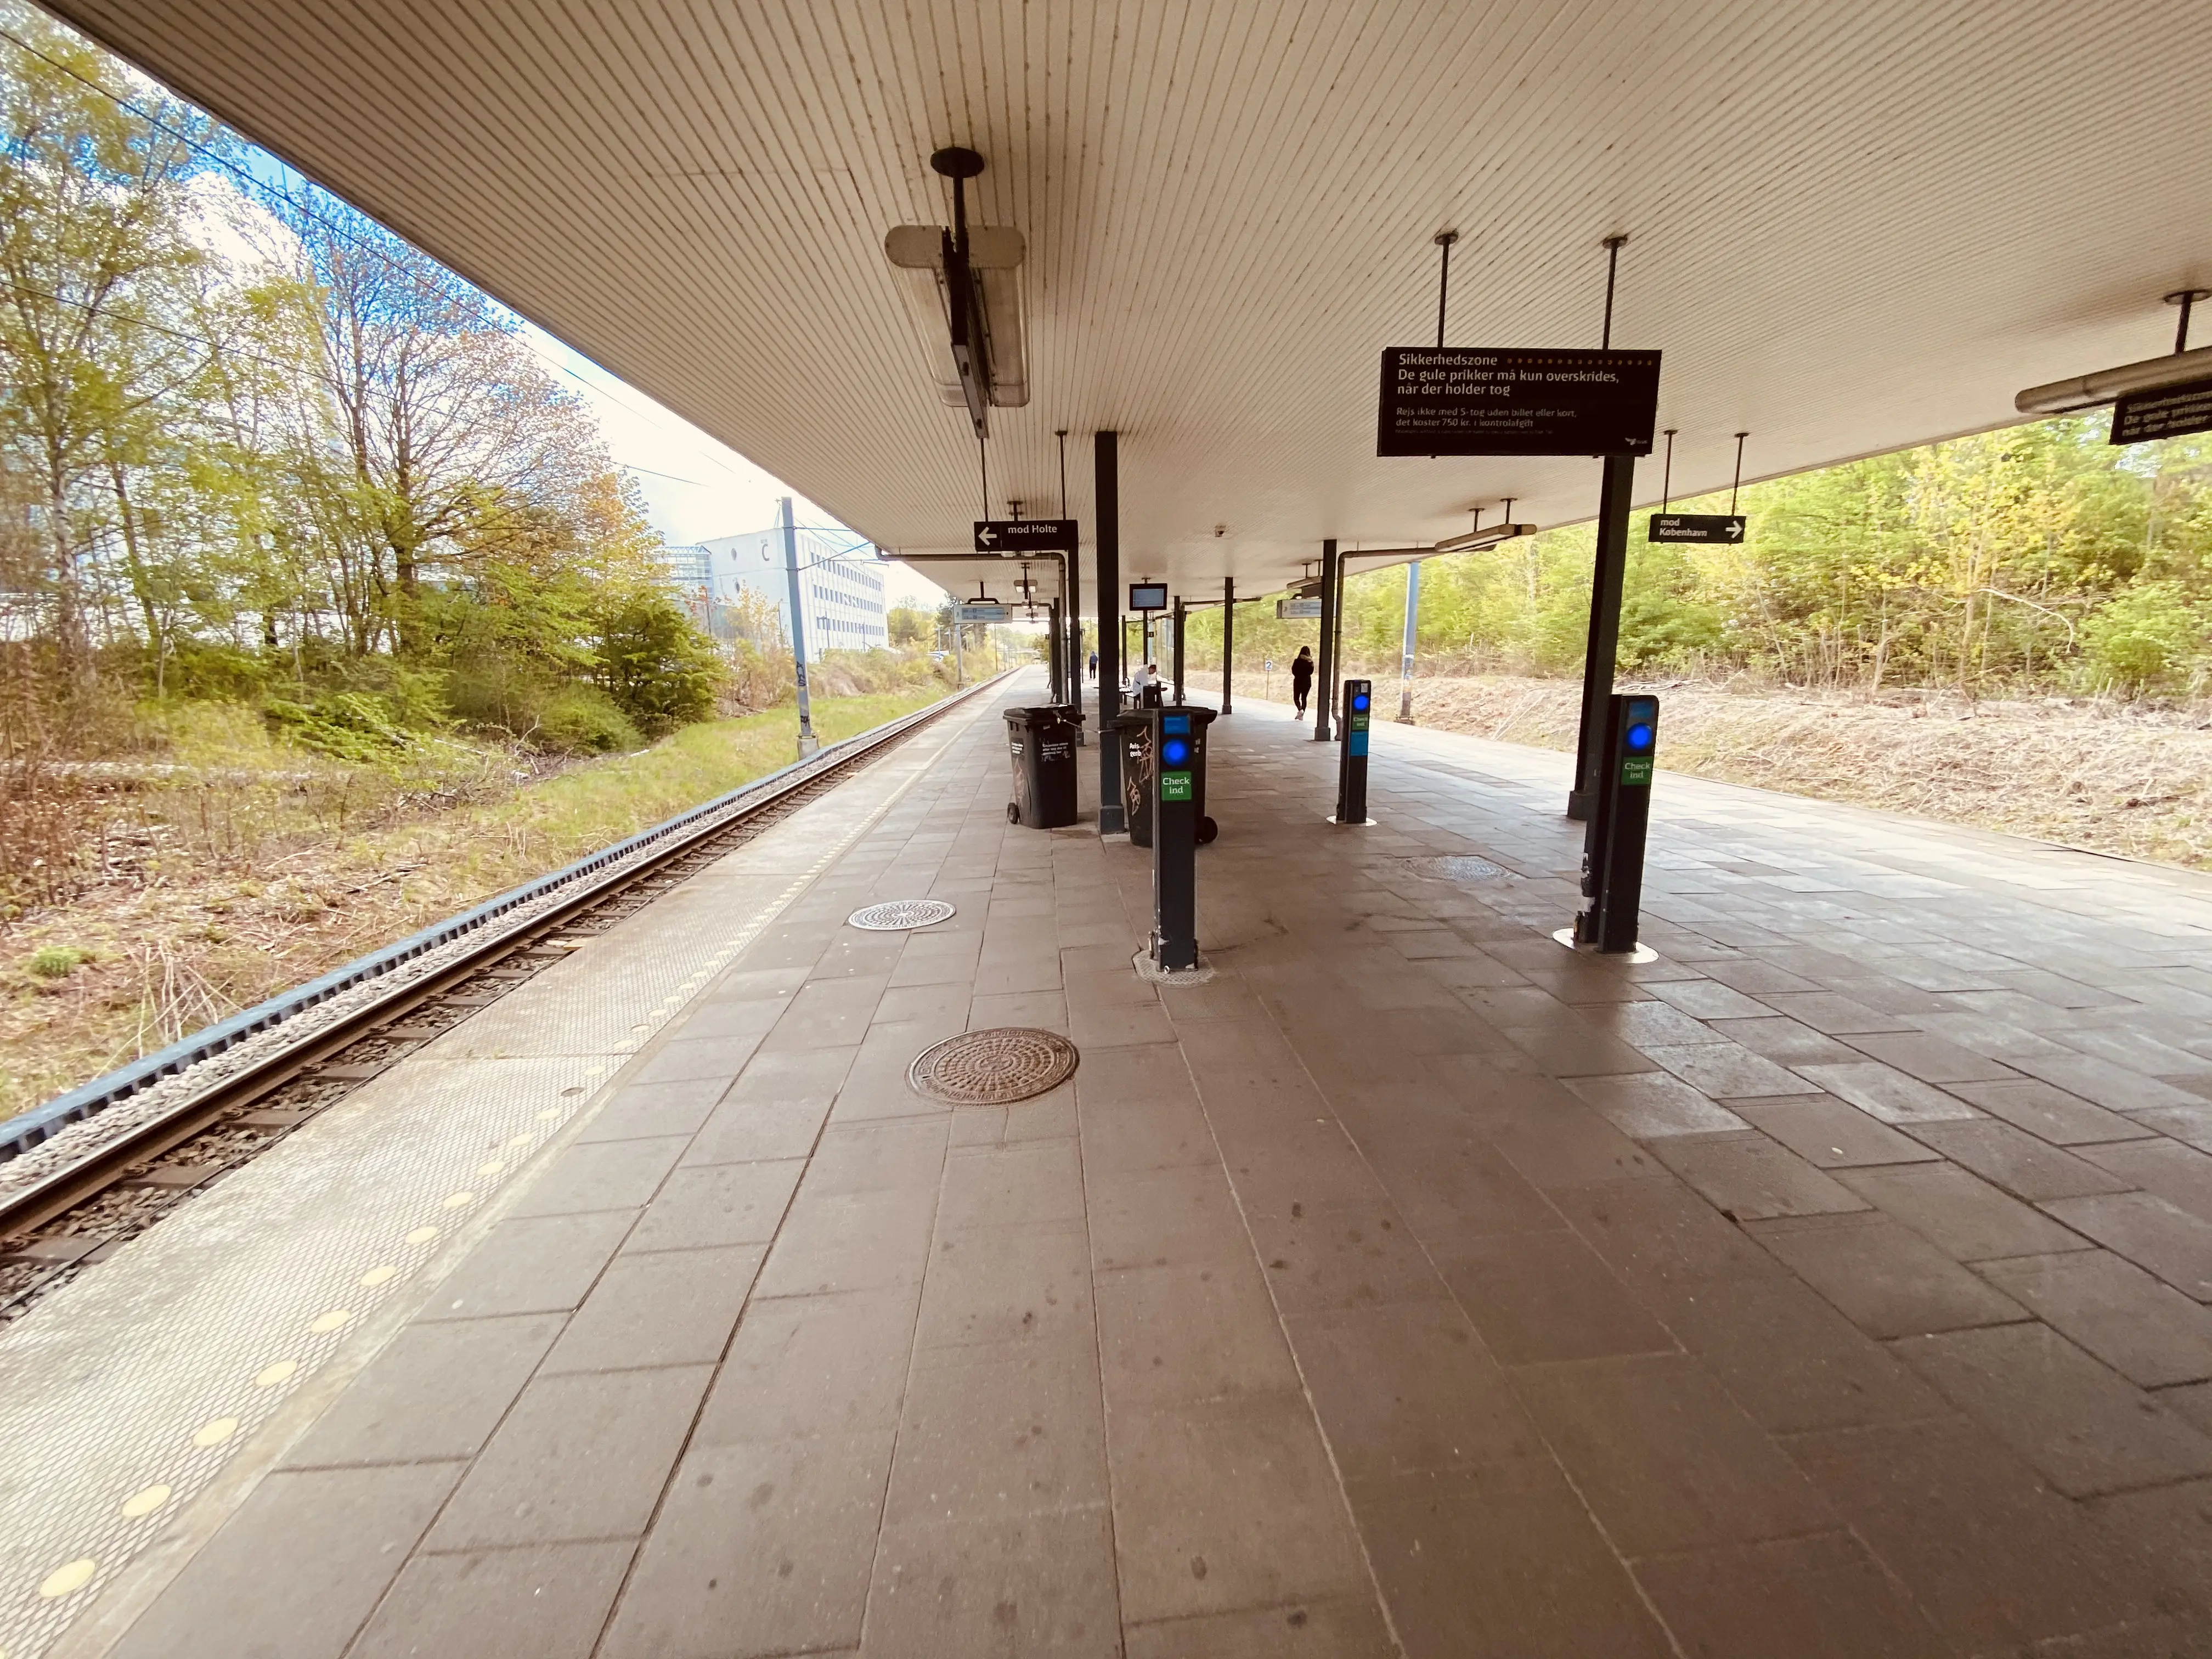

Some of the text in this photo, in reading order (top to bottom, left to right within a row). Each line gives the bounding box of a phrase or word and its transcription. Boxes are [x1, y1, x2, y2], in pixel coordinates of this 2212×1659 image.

[1399, 353, 1498, 365] Sikkerhedszone
[1398, 369, 1619, 383] De gule prikker må kun overskrides,
[1398, 382, 1510, 397] når der holder tog
[1396, 407, 1415, 416] Rejs
[1418, 407, 1436, 415] ikke
[1438, 407, 1458, 415] med
[1487, 408, 1509, 416] uden
[1536, 409, 1555, 417] eller
[1557, 409, 1578, 417] kort,
[1442, 418, 1458, 426] 750
[1480, 419, 1533, 428] kontrolafgift
[1660, 518, 1680, 526] mod
[1008, 524, 1057, 533] mod Holte
[1660, 528, 1707, 537] København
[1163, 777, 1190, 785] Check
